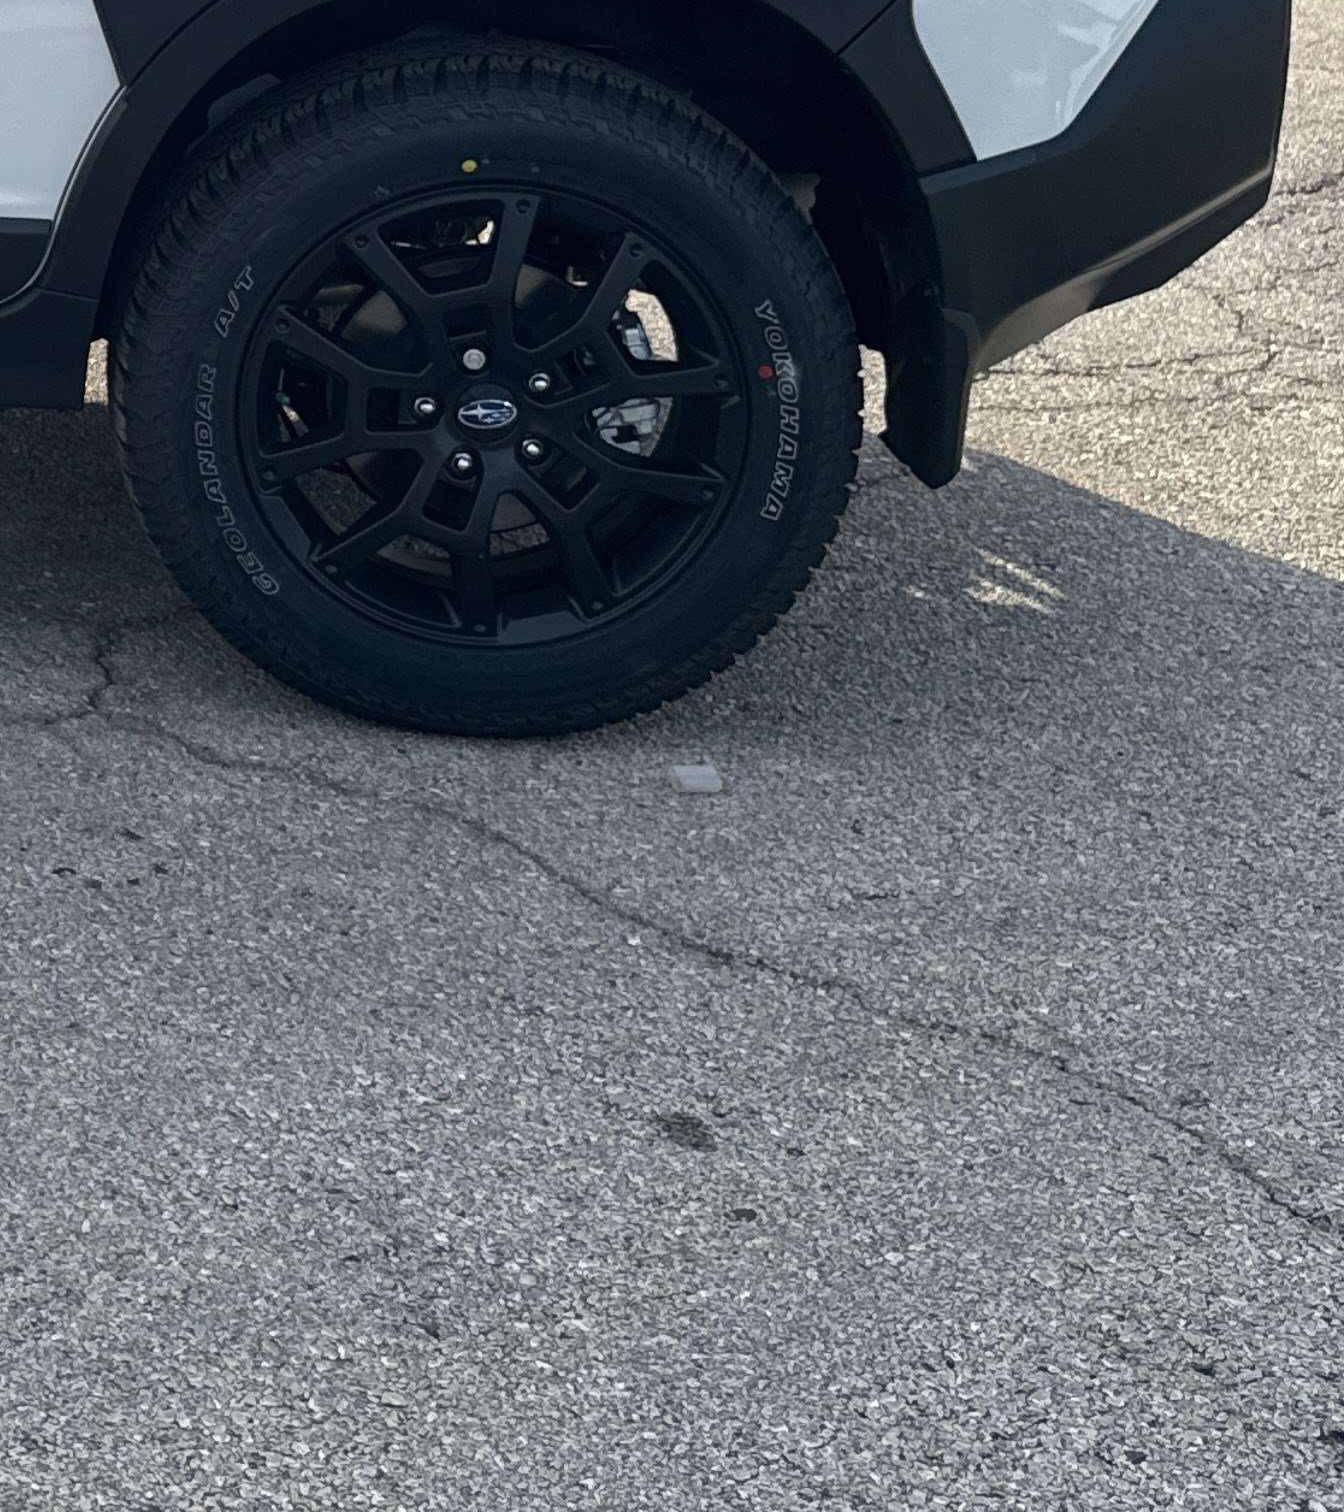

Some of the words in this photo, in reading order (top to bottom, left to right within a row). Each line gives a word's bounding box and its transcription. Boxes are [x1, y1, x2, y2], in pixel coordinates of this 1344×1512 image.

[213, 265, 255, 338] A/T
[754, 299, 800, 522] YOKOHAMA
[194, 363, 280, 595] GEOLANDAR
